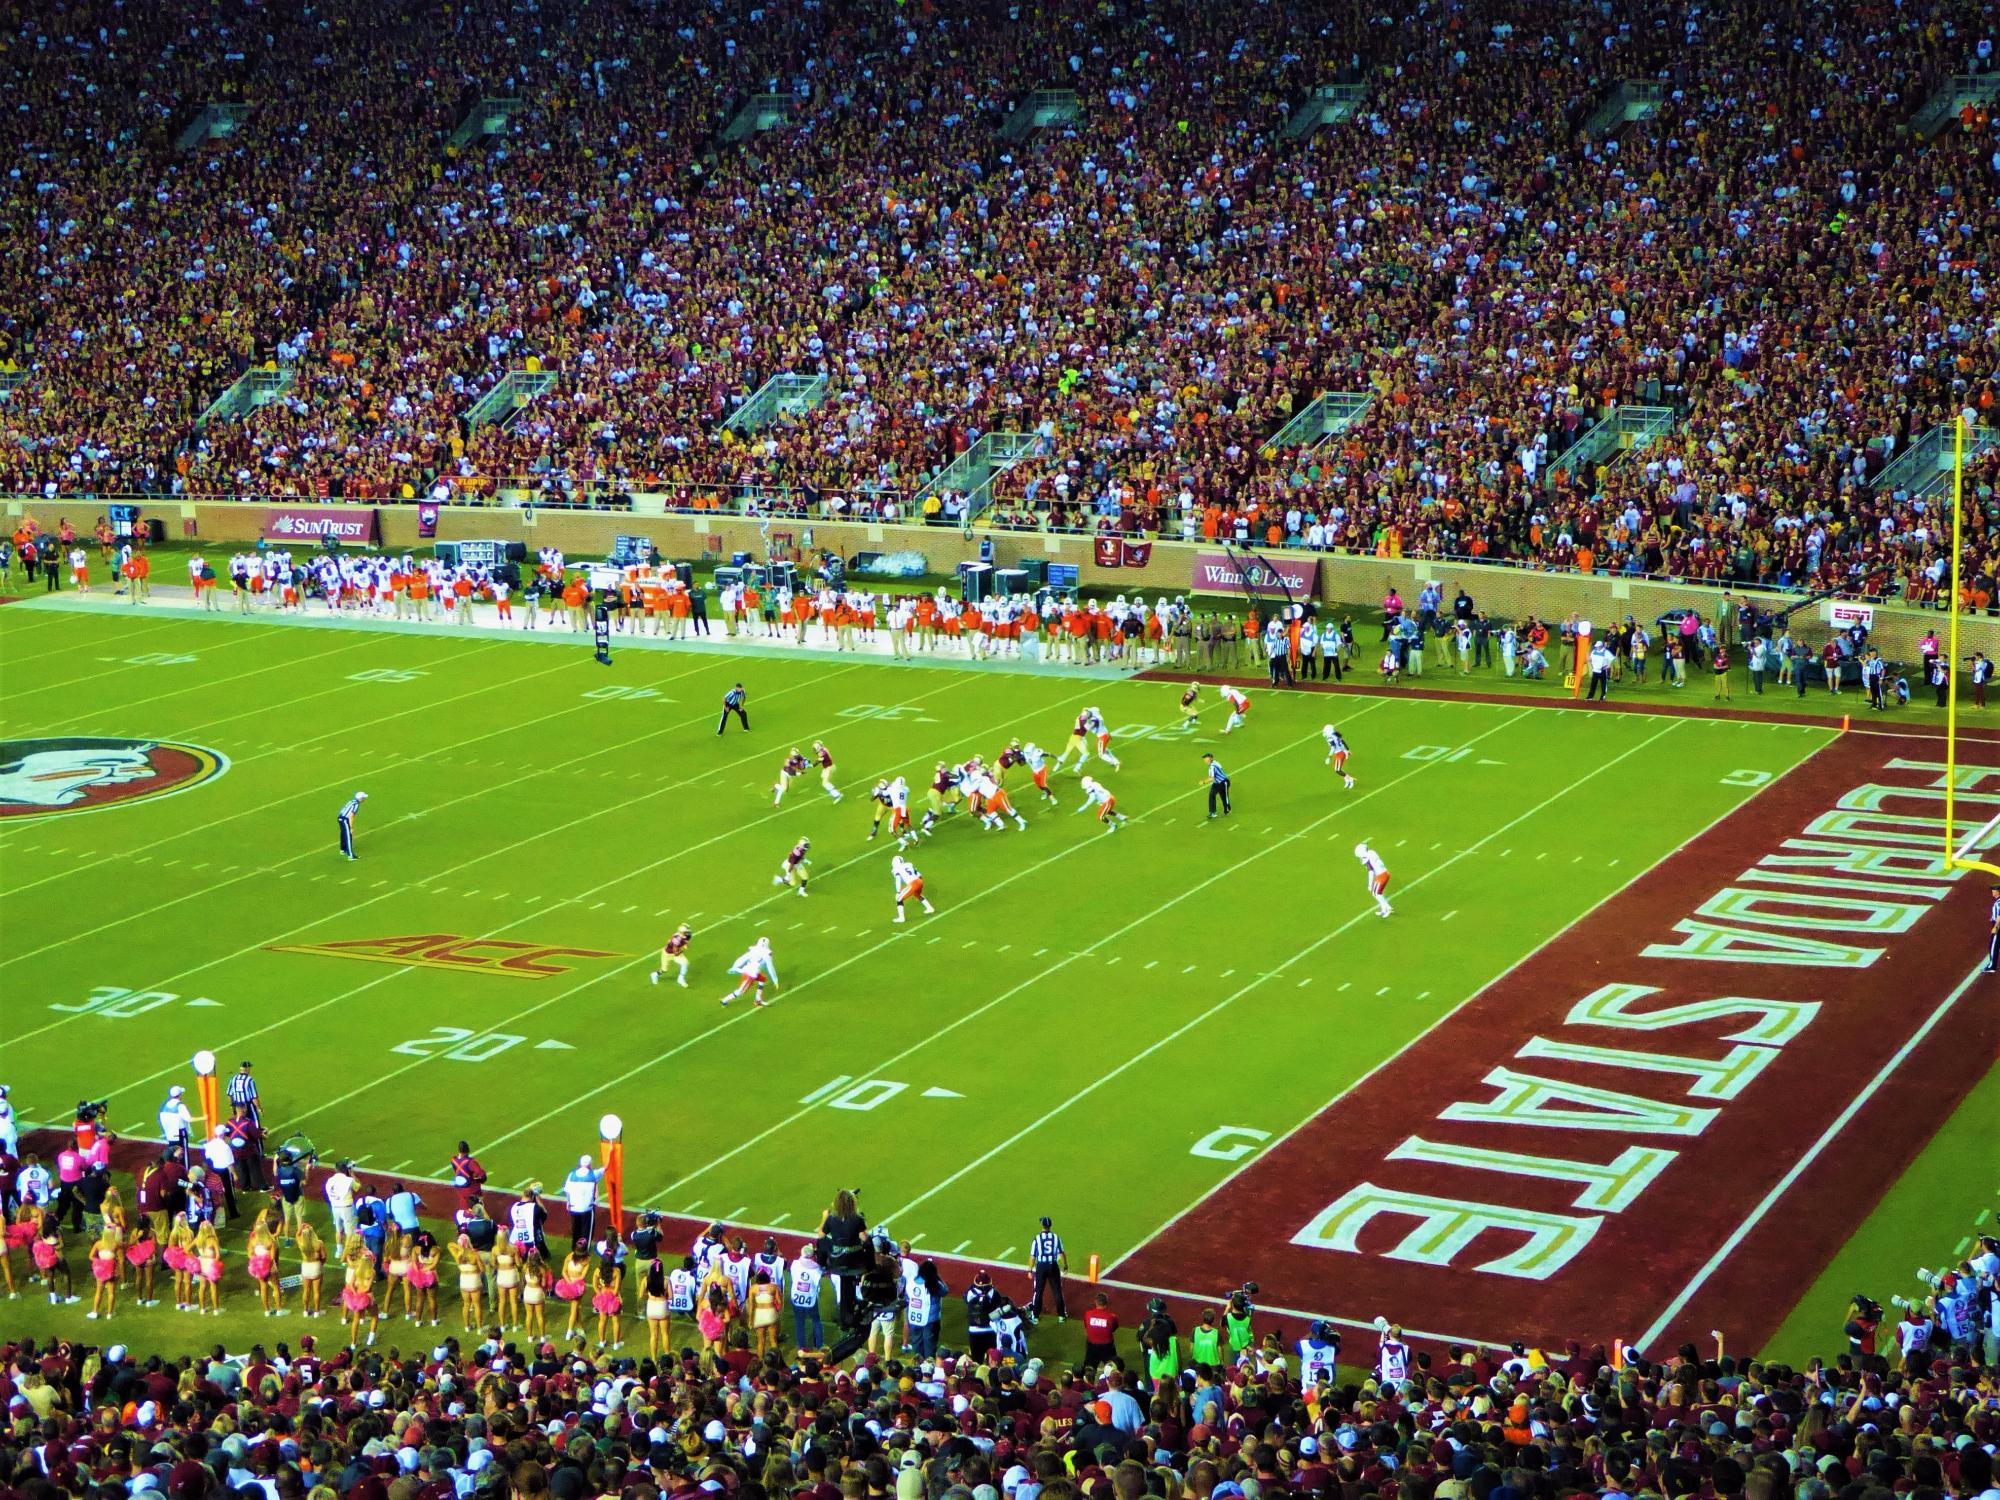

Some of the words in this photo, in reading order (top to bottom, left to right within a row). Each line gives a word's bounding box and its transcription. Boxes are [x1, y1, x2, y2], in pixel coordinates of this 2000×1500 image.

[1204, 565, 1243, 584] Winn
[1262, 569, 1304, 588] Dixie
[1400, 744, 1474, 762] 10
[1719, 769, 1773, 787] G
[300, 934, 636, 977] ACC
[47, 986, 181, 1018] 30
[390, 1027, 527, 1062] 20
[798, 1075, 910, 1111] 10
[1290, 983, 1823, 1281] STATE
[1189, 1125, 1273, 1161] G
[517, 1230, 530, 1242] 85
[1044, 1240, 1053, 1254] S
[793, 1294, 812, 1306] 204
[910, 1311, 923, 1323] 69
[300, 1364, 313, 1384] 5
